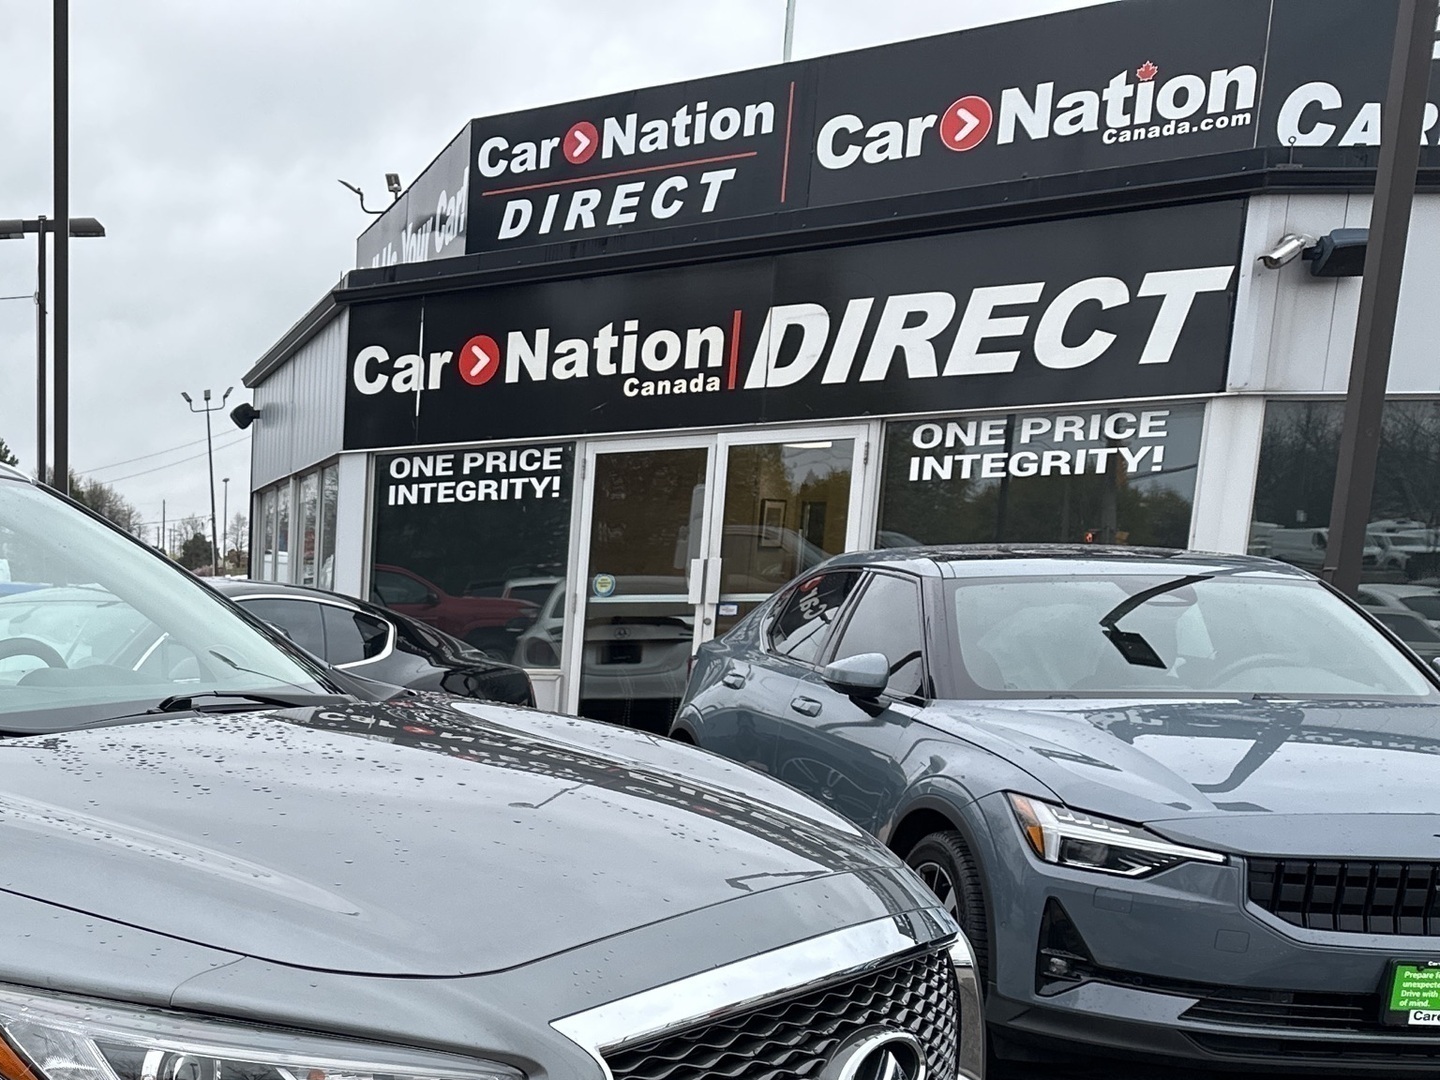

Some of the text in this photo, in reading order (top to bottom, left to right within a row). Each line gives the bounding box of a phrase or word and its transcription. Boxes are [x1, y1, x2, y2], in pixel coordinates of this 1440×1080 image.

[1102, 109, 1252, 145] Canada.com
[498, 168, 737, 240] DIRECT
[744, 265, 1235, 389] DIRECT
[623, 373, 721, 397] Canada
[911, 410, 1170, 449] ONE PRICE
[389, 447, 563, 479] ONE PRICE
[908, 446, 1165, 481] INTEGRITY!
[388, 475, 561, 506] INTEGRITY!
[1404, 971, 1434, 980] Prepare
[1409, 999, 1430, 1007] mind.
[1422, 990, 1439, 998] with
